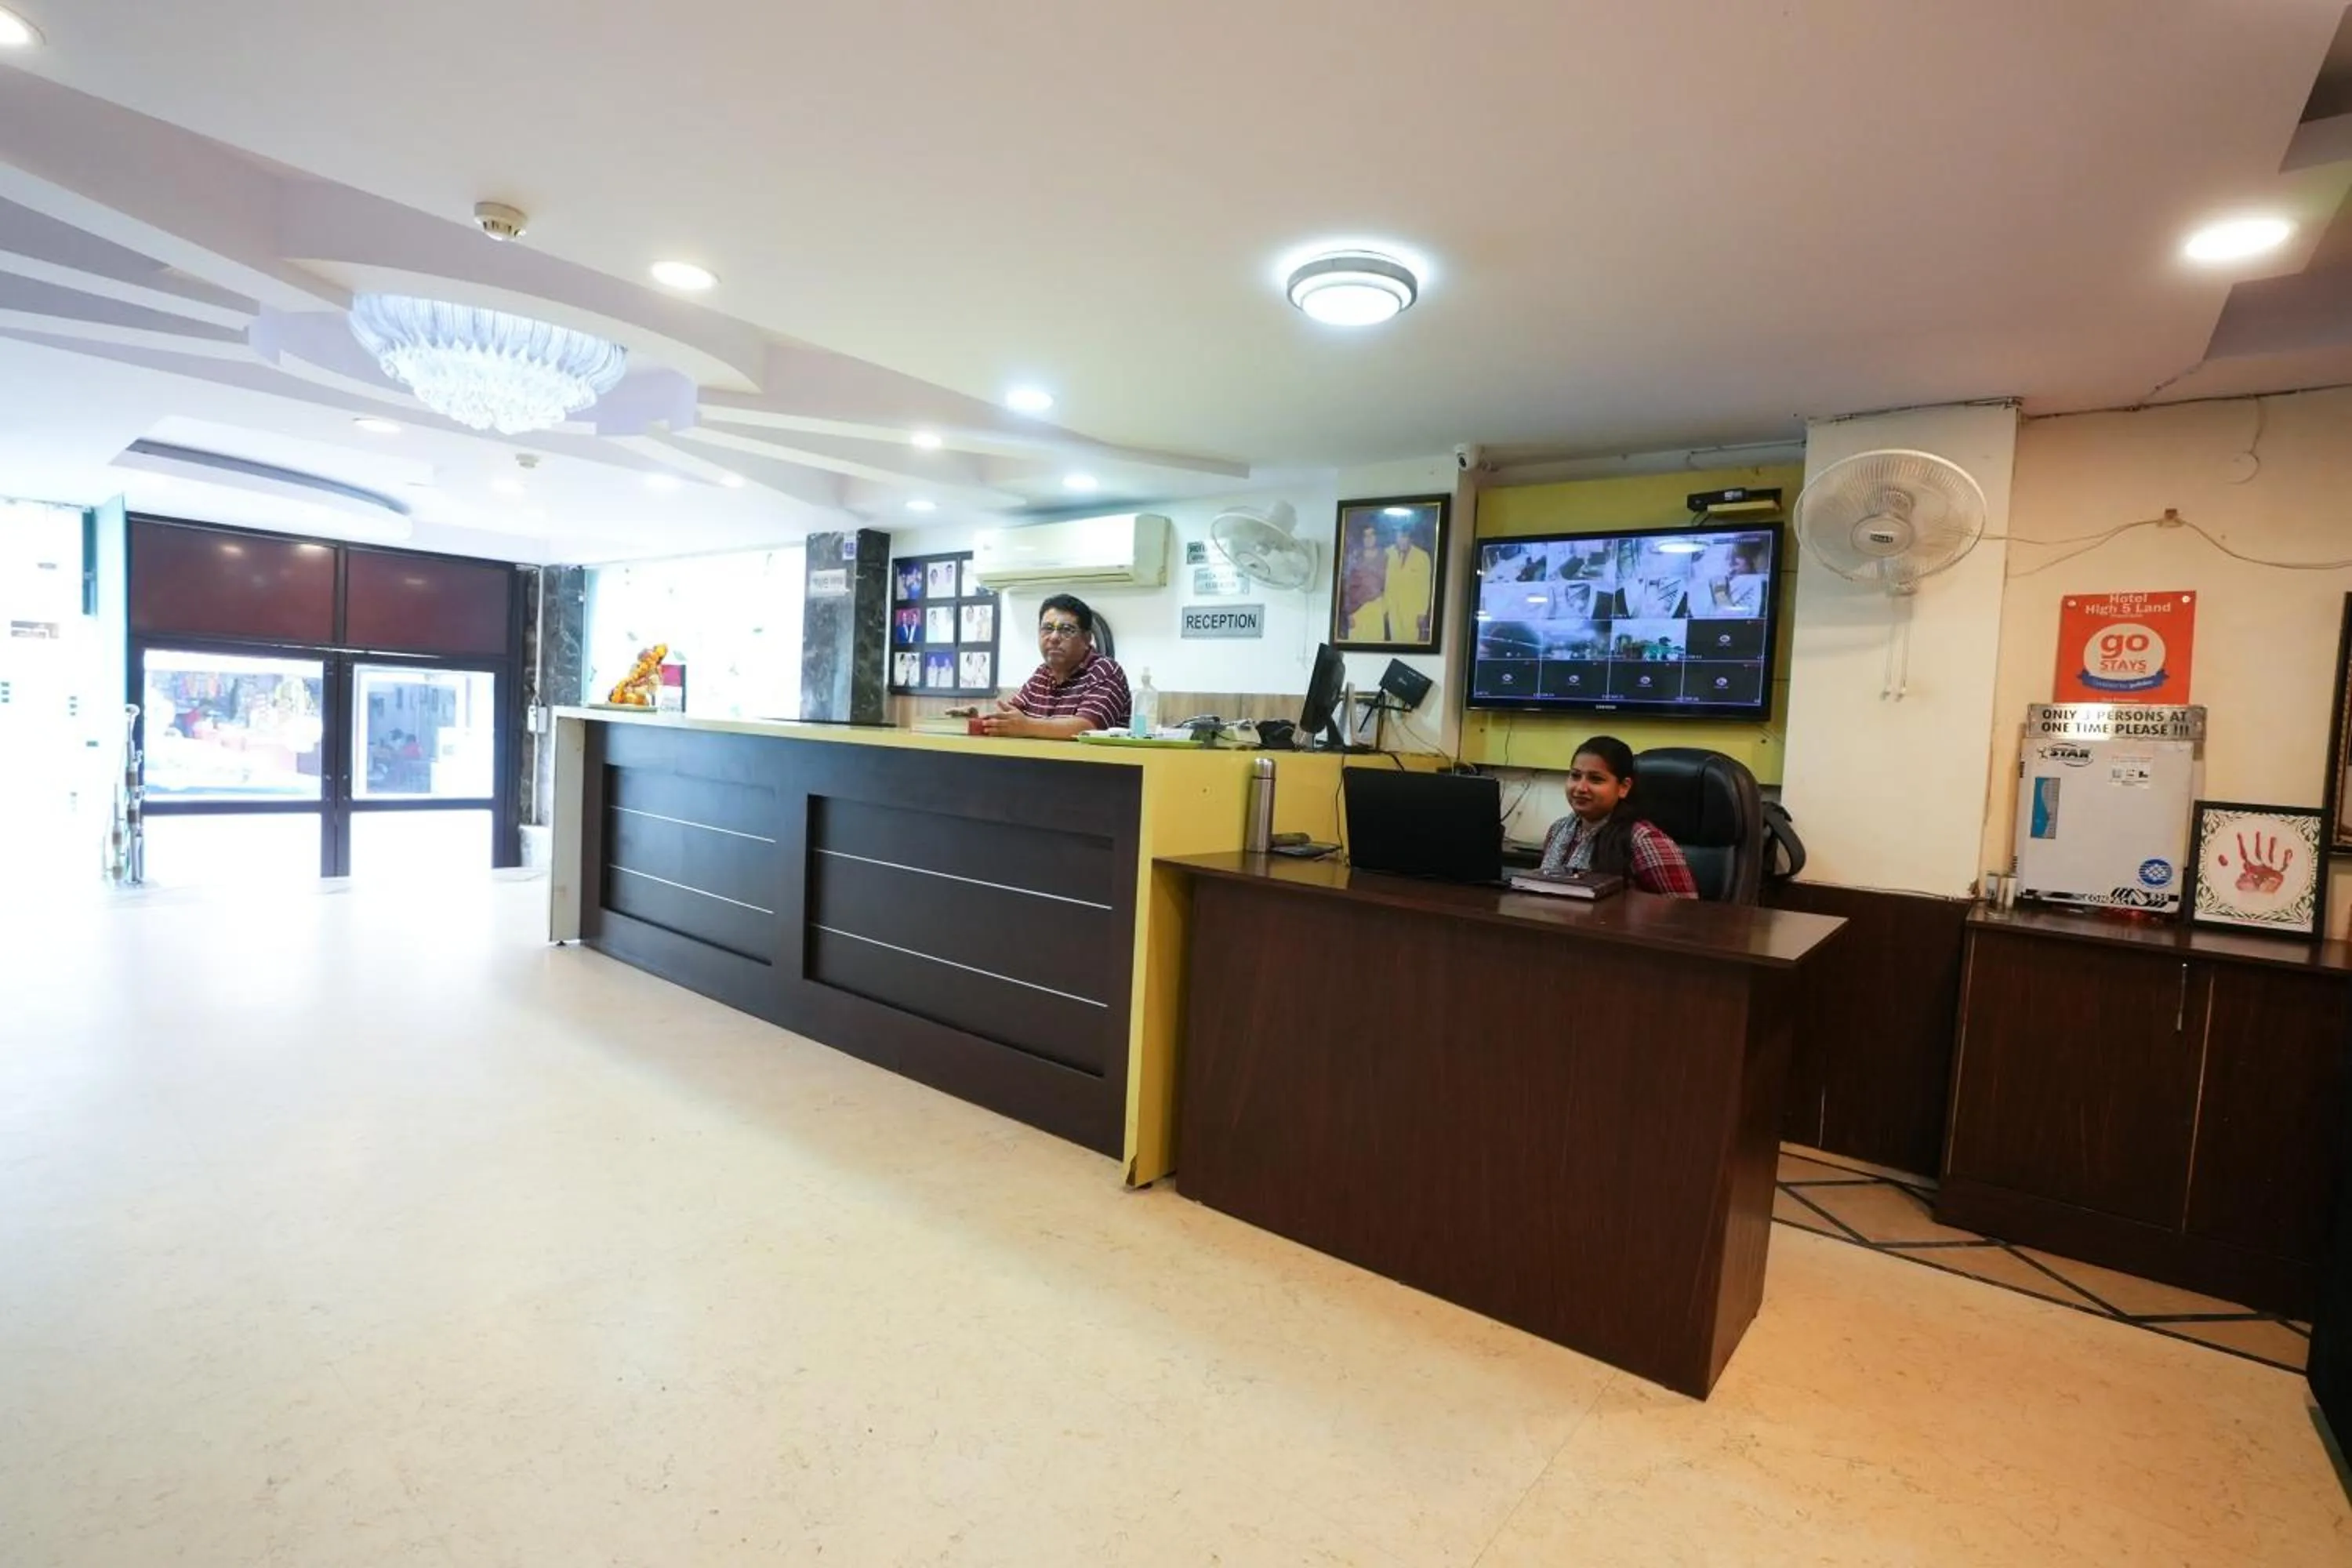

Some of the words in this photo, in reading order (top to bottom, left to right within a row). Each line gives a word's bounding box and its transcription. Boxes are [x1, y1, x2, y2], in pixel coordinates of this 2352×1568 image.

[2109, 593, 2148, 603] Hotel
[2085, 604, 2117, 615] High
[2122, 603, 2131, 614] 5
[2136, 602, 2172, 613] Land
[1186, 614, 1257, 629] RECEPTION
[2100, 633, 2150, 659] go
[2100, 659, 2147, 671] STAYS
[2042, 709, 2077, 720] ONLY
[2096, 710, 2165, 722] PERSONS
[2169, 711, 2187, 722] AT
[2042, 722, 2069, 733] ONE
[2074, 722, 2110, 734] TIME
[2115, 724, 2168, 735] PLEASE
[2173, 725, 2190, 736] !!!
